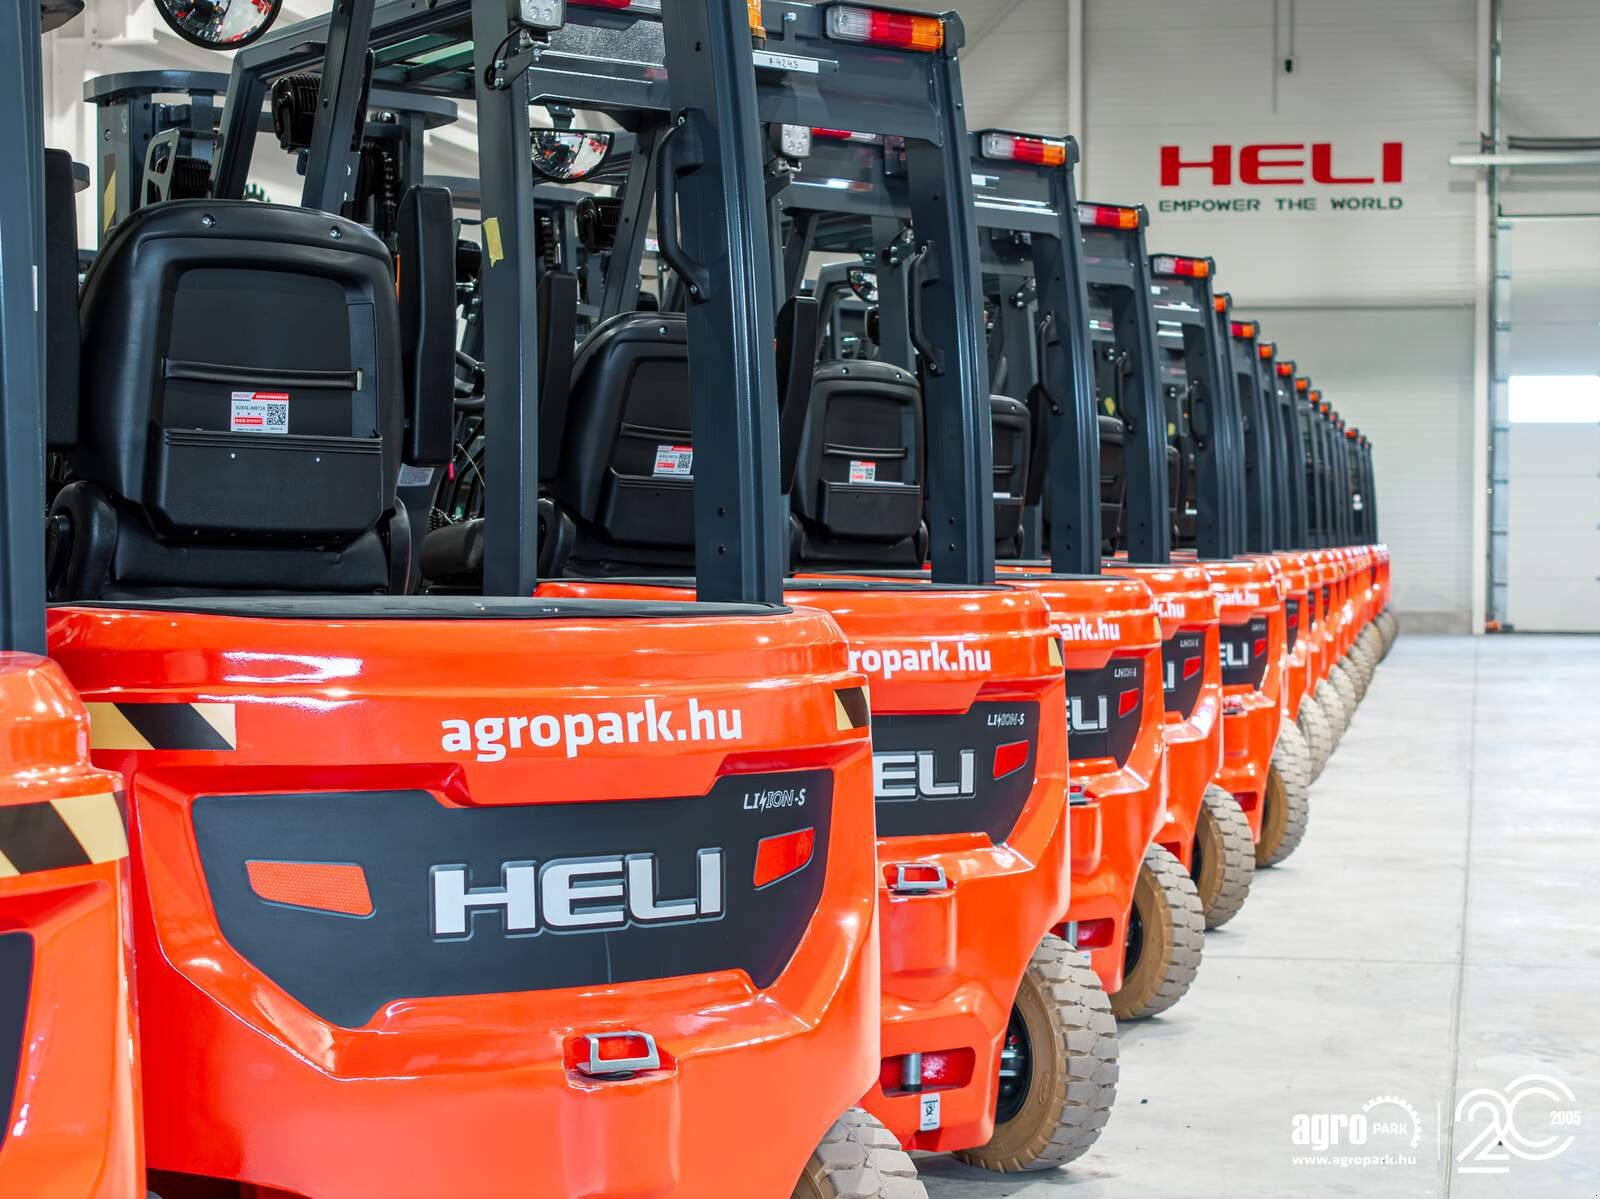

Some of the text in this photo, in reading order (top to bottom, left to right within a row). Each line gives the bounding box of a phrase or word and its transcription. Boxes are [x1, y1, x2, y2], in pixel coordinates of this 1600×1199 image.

[1160, 142, 1403, 187] HELI
[1159, 196, 1404, 213] EMPOWER THE WORLD
[848, 641, 992, 680] ropark.hu
[441, 697, 743, 763] agropark.hu
[873, 751, 975, 798] ELI
[433, 850, 723, 936] HELI
